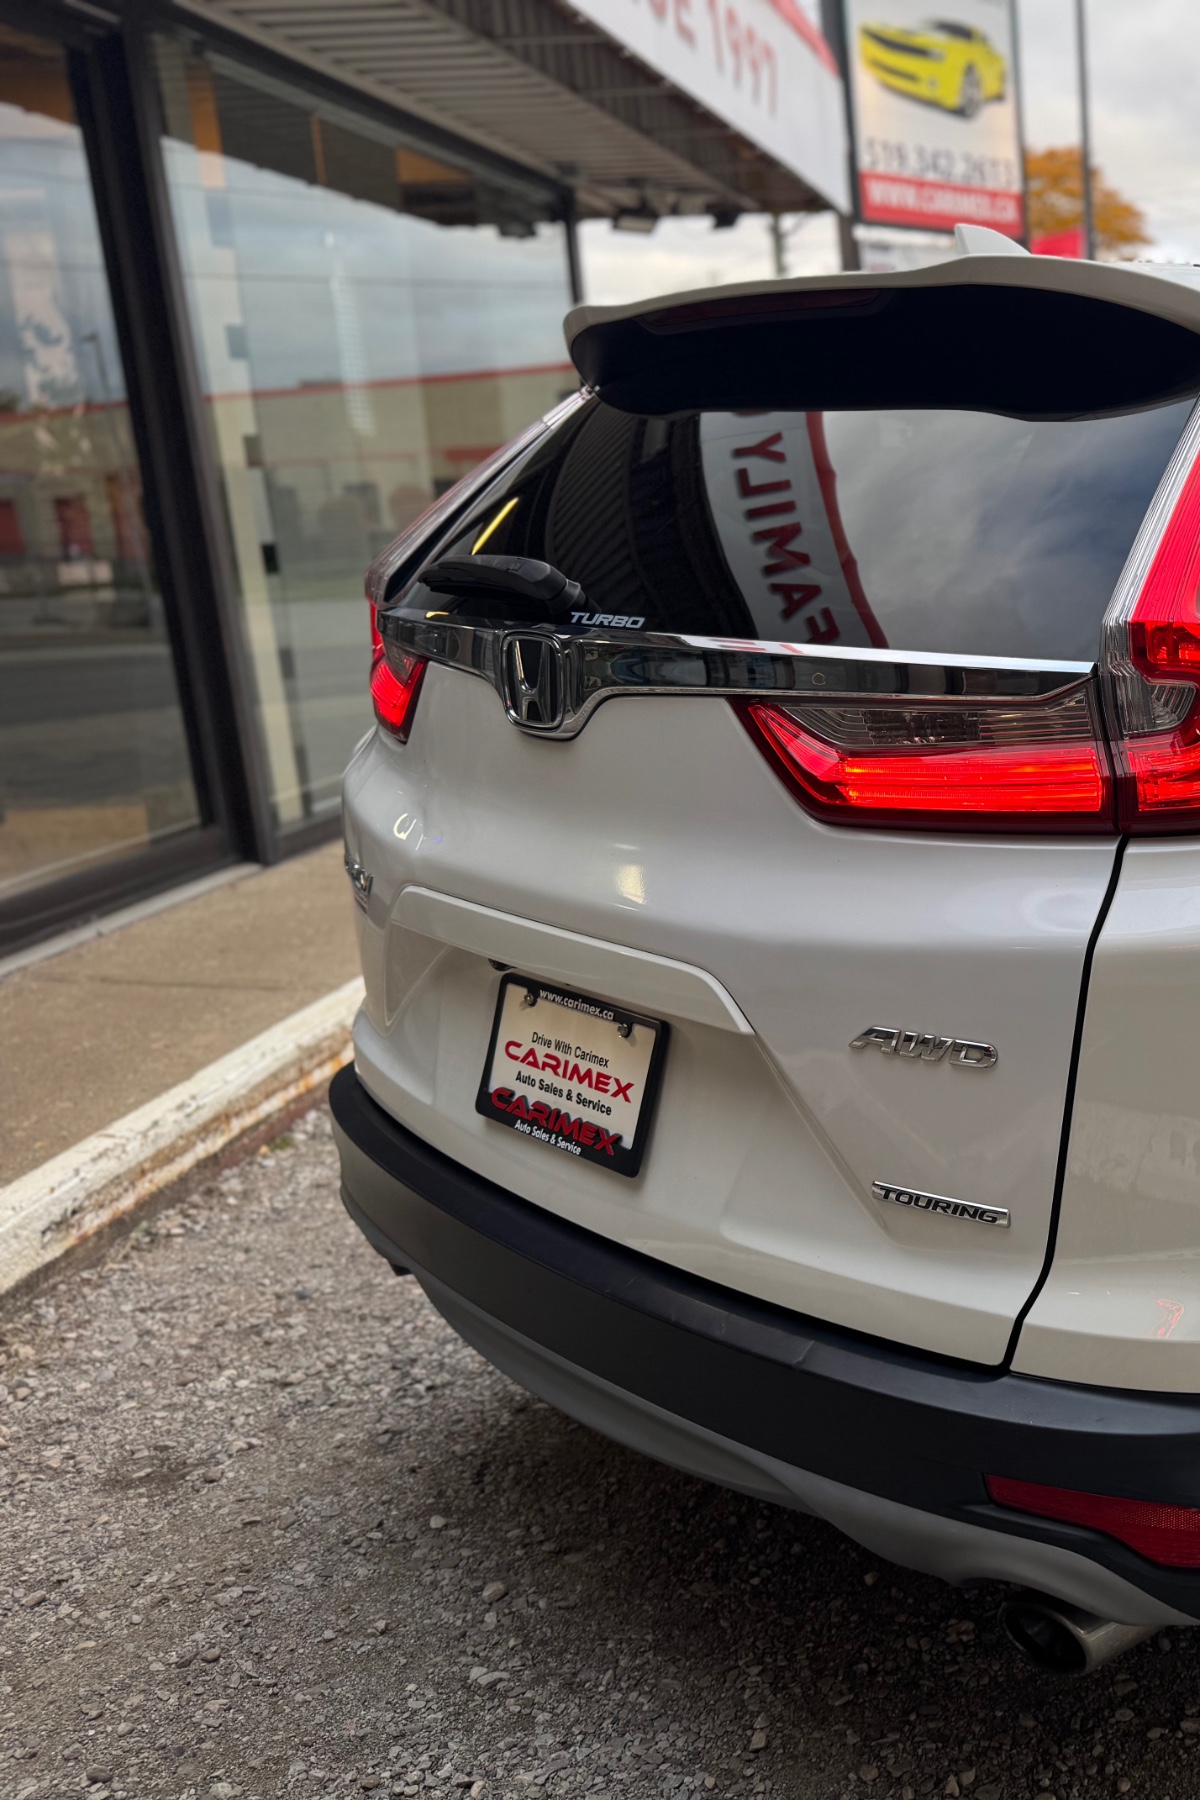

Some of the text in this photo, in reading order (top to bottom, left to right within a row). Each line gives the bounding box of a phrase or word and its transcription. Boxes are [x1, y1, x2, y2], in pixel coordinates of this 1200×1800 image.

[571, 612, 645, 628] TURBO
[539, 989, 615, 1021] www.carimex.ca
[532, 1031, 609, 1069] Drive With Carimex
[848, 1024, 998, 1069] AWD
[504, 1040, 635, 1103] CARIMEX
[515, 1070, 612, 1116] Auto Sales & Service
[491, 1087, 620, 1156] CARIMEX
[514, 1119, 582, 1155] Auto Sales & Service
[879, 1186, 999, 1225] TOURING
